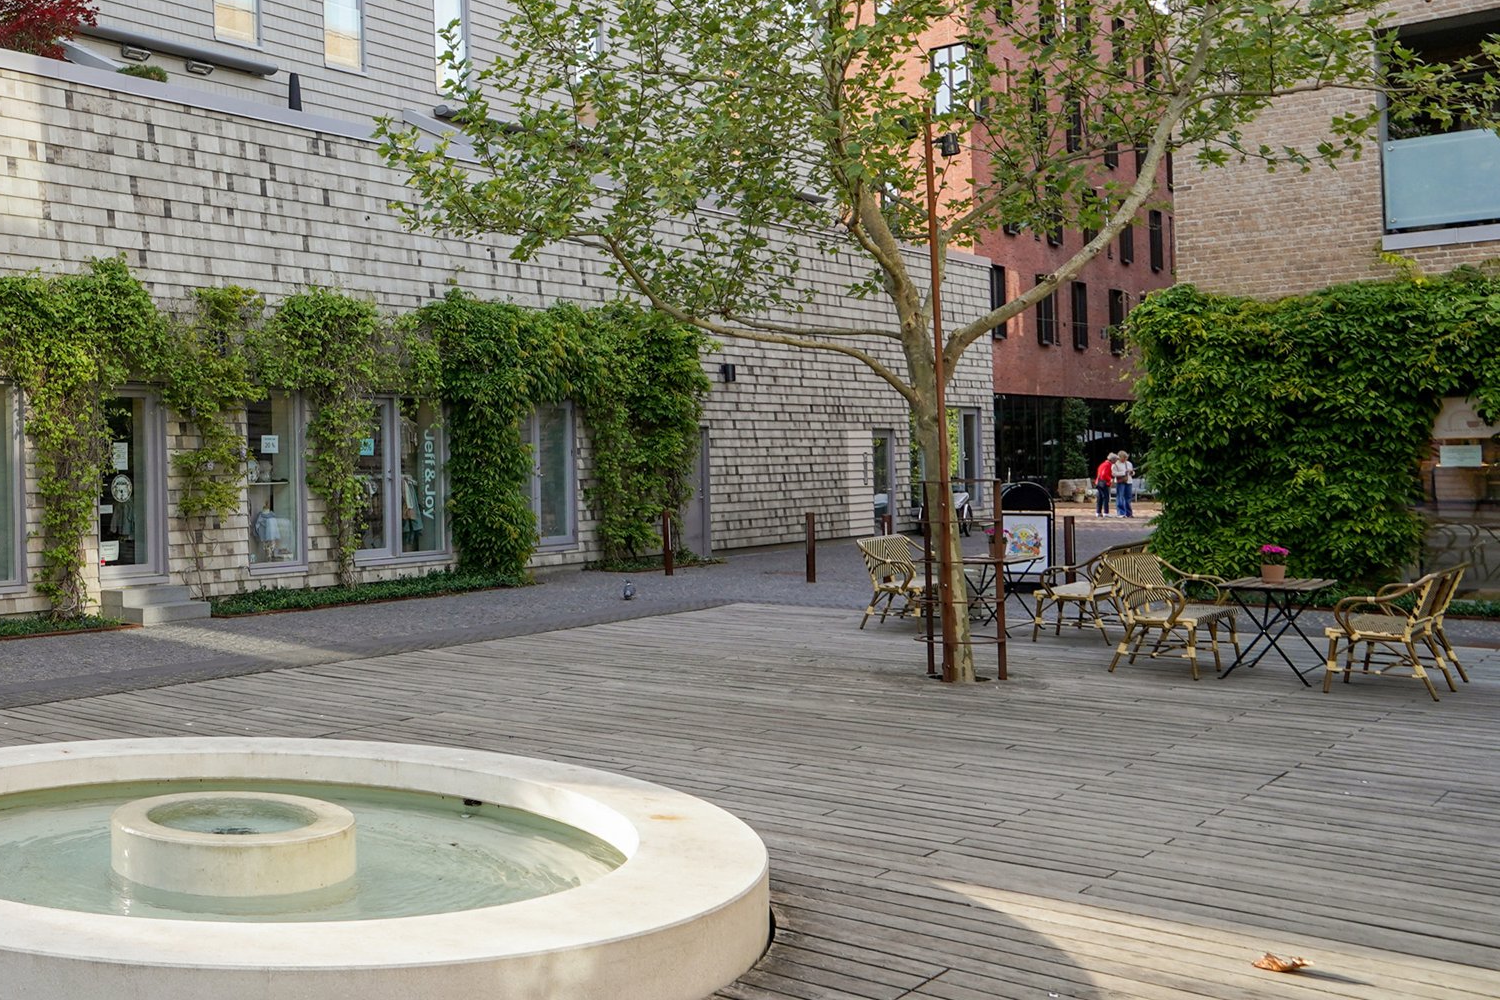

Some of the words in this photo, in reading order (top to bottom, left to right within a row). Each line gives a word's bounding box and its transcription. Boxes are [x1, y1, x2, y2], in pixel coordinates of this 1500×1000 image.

[424, 429, 436, 466] Jeff
[424, 468, 436, 482] &
[422, 484, 436, 519] Joy
